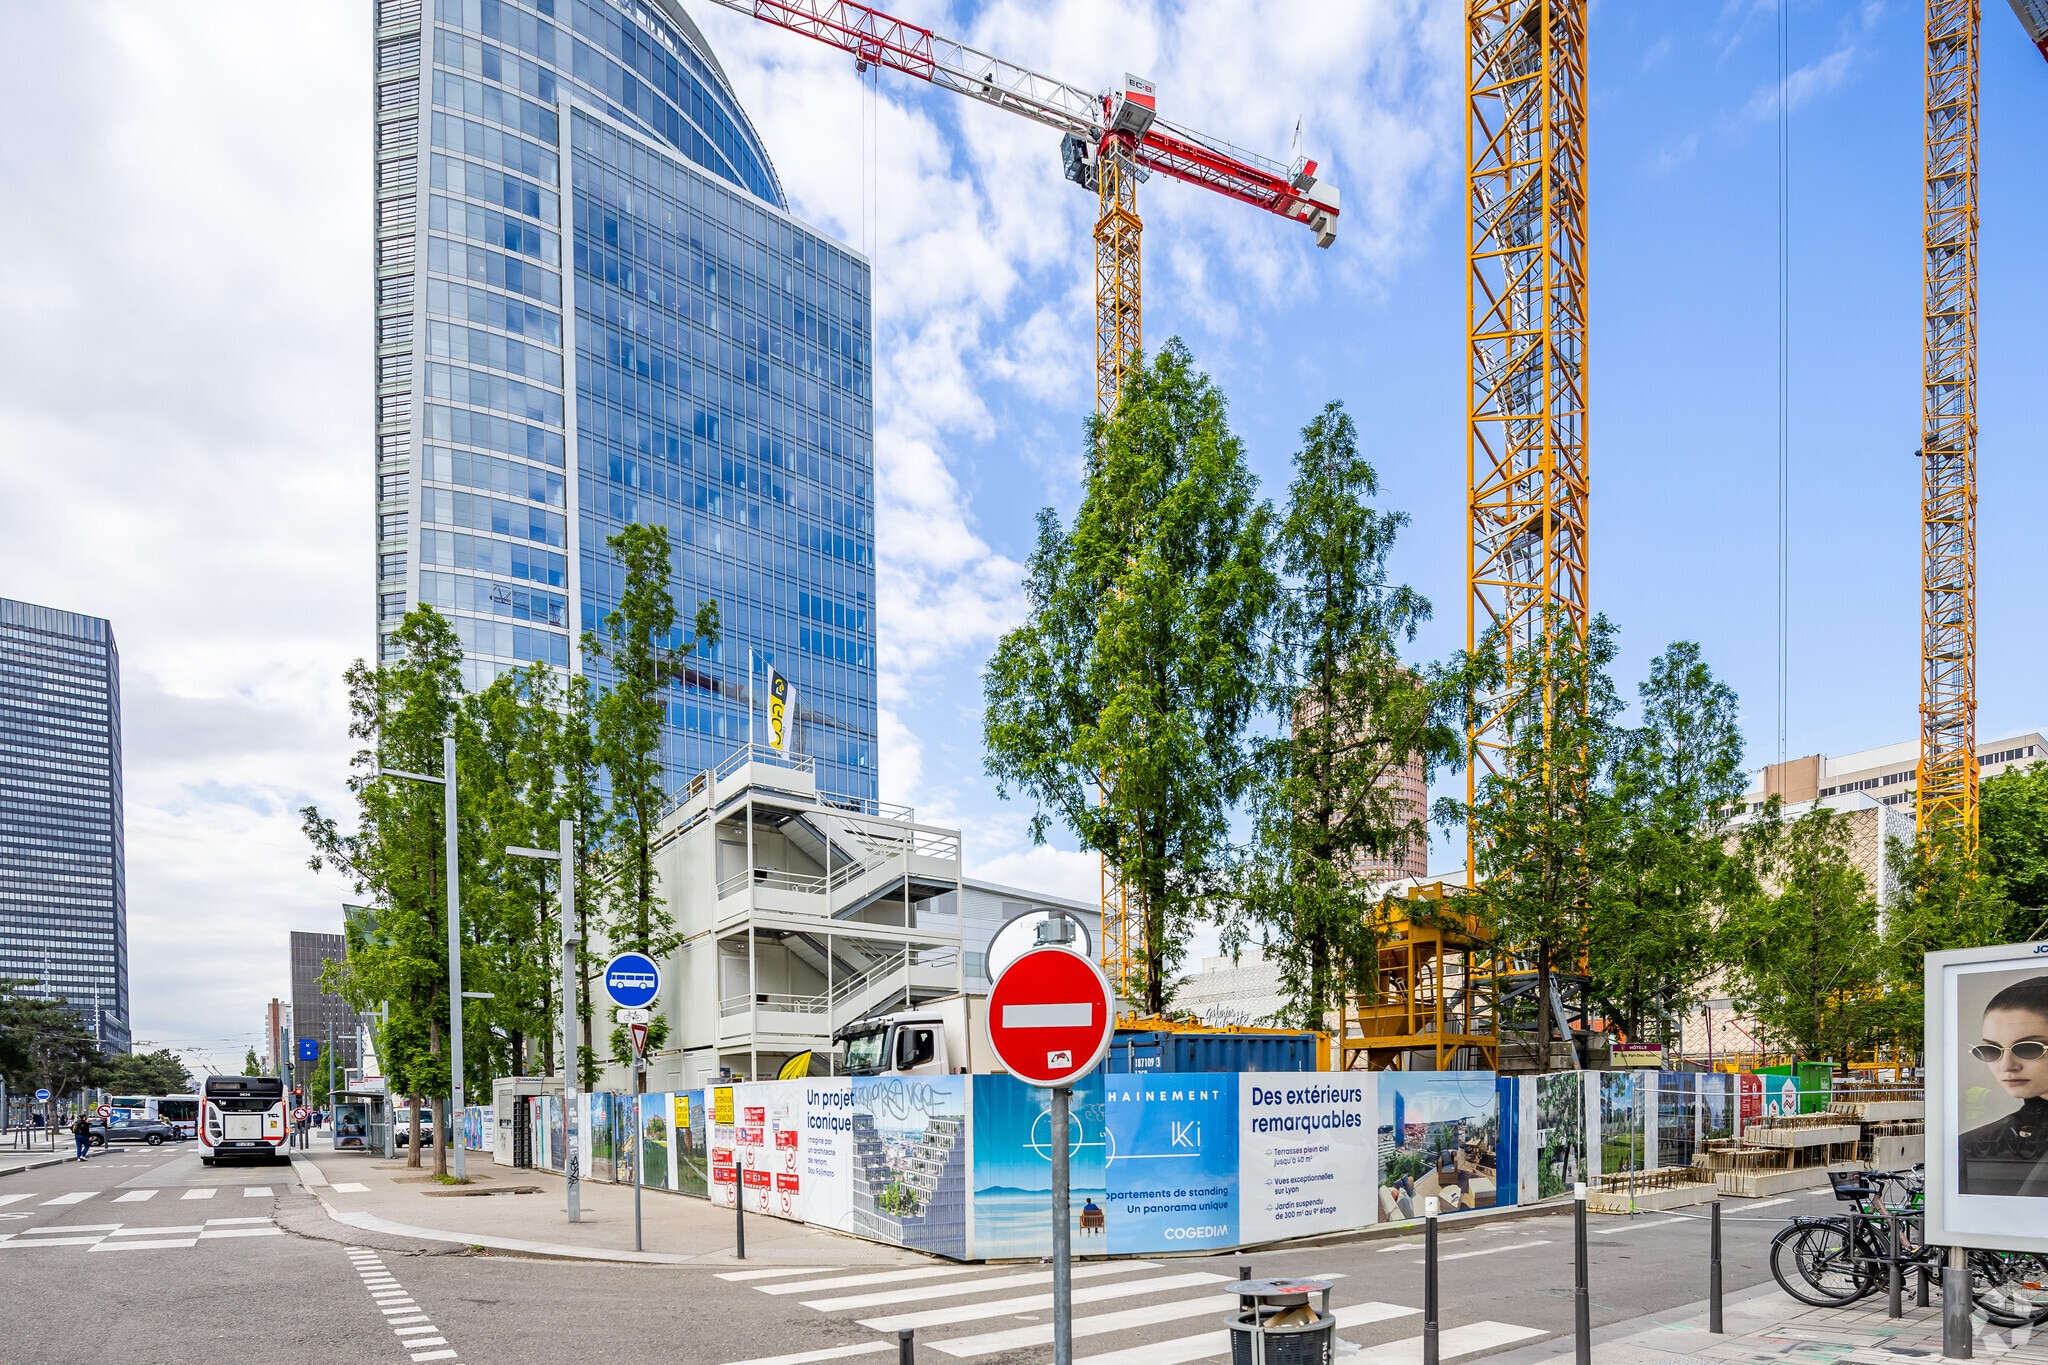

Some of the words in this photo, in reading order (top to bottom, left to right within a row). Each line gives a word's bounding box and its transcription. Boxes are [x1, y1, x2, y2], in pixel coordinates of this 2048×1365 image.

[1135, 1057, 1154, 1068] 187109
[807, 1089, 820, 1105] Un
[822, 1088, 855, 1110] projet
[1252, 1087, 1282, 1106] Des
[1286, 1085, 1362, 1105] extérieurs
[807, 1112, 852, 1134] iconique
[1252, 1110, 1362, 1134] remarquables
[1303, 1145, 1318, 1154] plein
[1318, 1144, 1330, 1152] ciel
[1290, 1173, 1334, 1183] exceptionnelles
[1173, 1188, 1186, 1198] de
[1189, 1186, 1229, 1197] standing
[1285, 1186, 1299, 1195] Lyon
[1127, 1205, 1141, 1214] Un
[1143, 1202, 1197, 1215] panorama
[1199, 1200, 1229, 1211] unique
[1275, 1201, 1295, 1210] Jardin
[1295, 1198, 1324, 1208] suspendu
[1275, 1212, 1283, 1220] de
[1320, 1206, 1337, 1214] étage
[1164, 1225, 1229, 1240] COGEDIM
